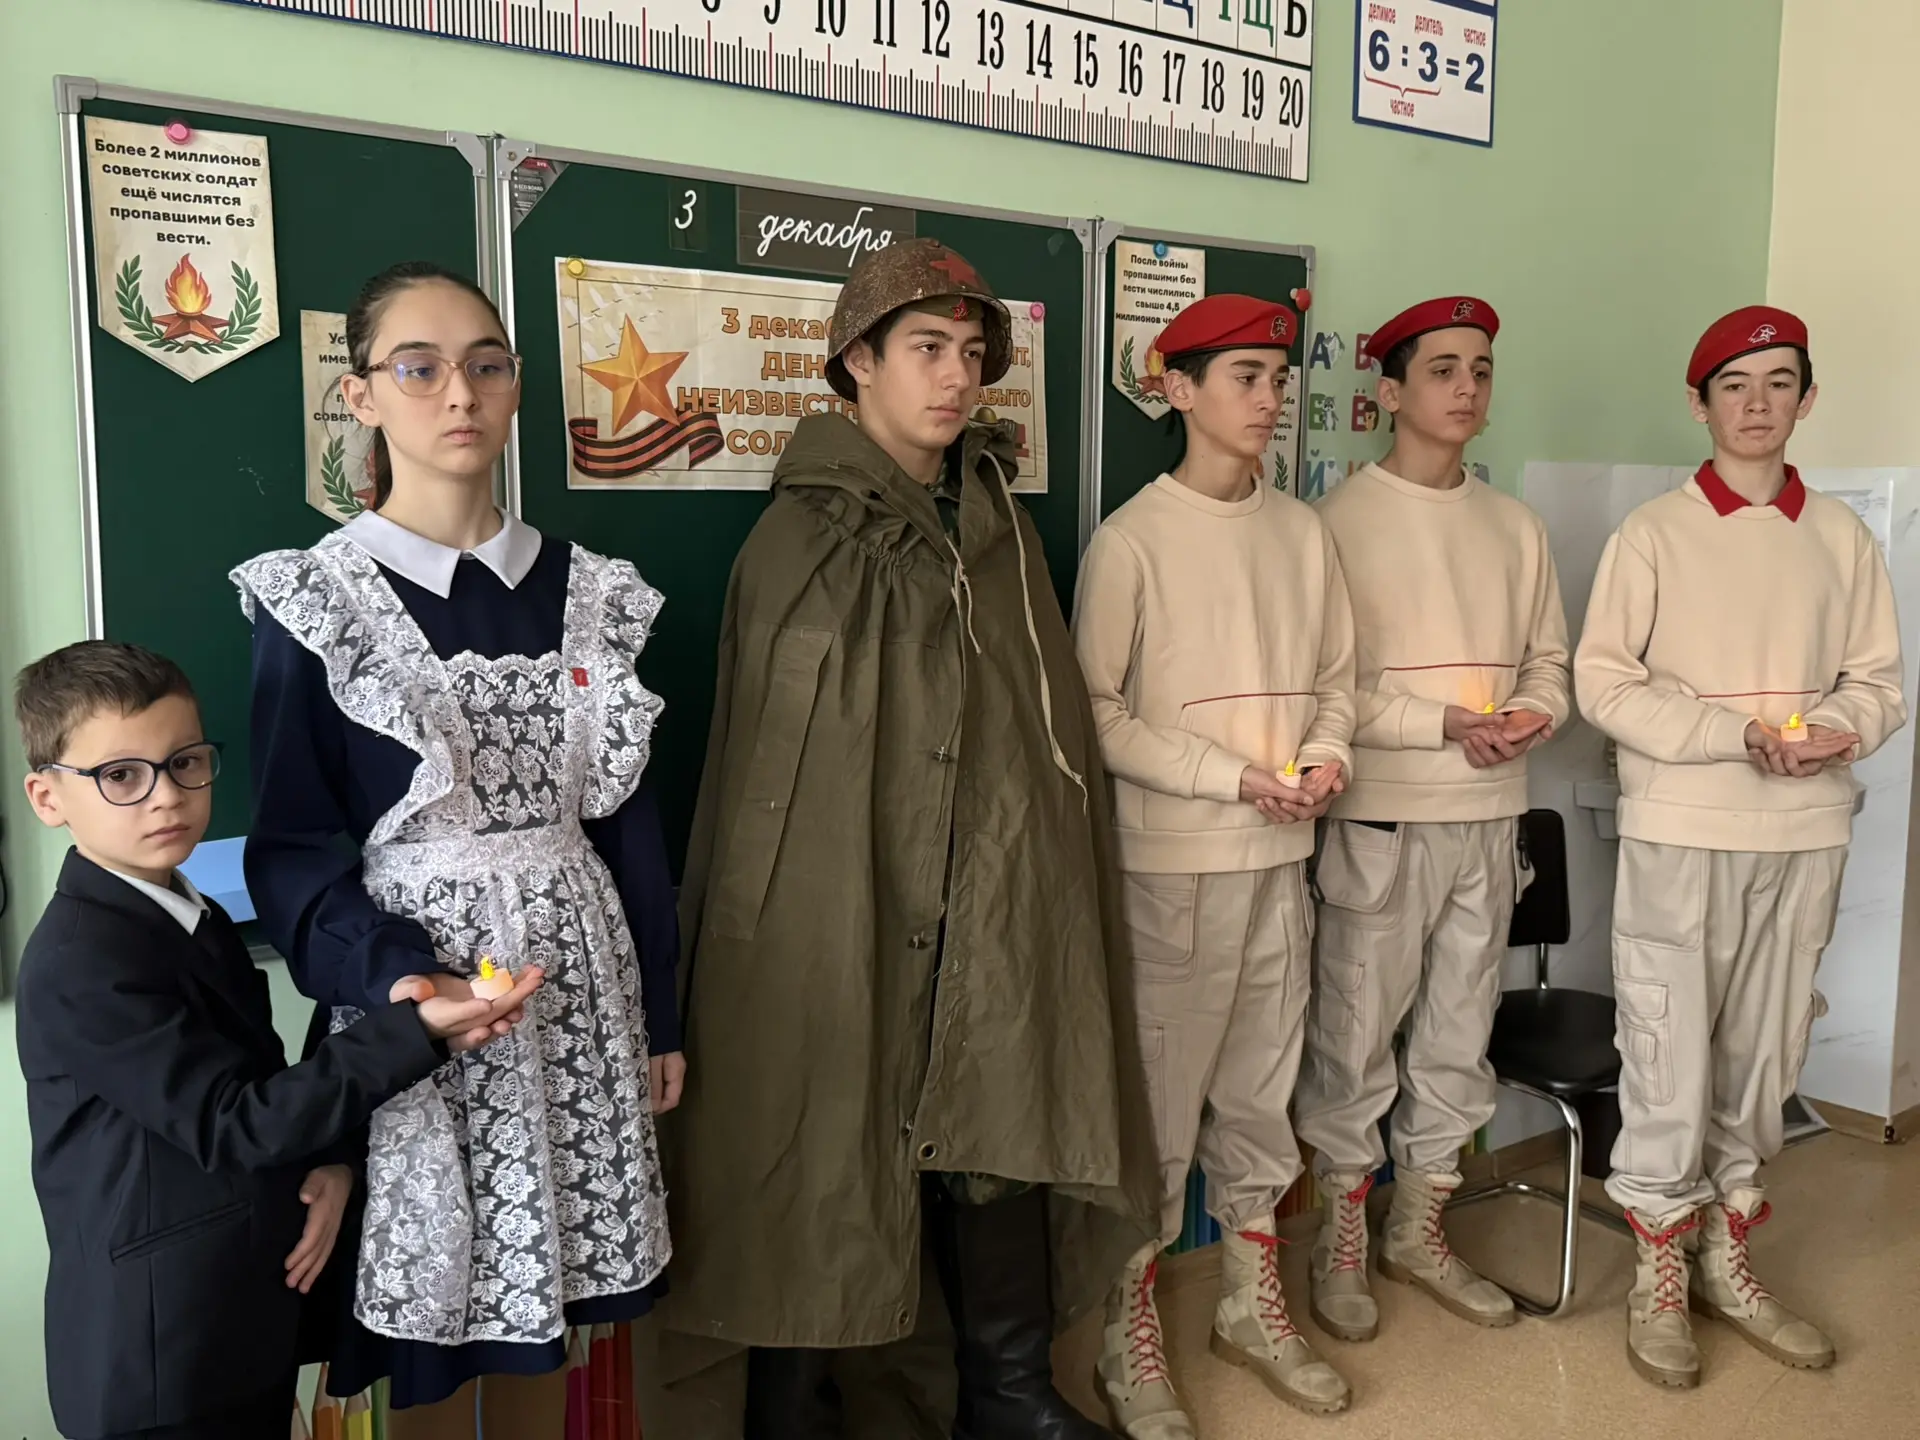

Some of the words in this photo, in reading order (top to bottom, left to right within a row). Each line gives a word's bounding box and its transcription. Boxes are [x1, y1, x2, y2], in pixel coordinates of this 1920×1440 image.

[1368, 3, 1396, 25] делимое
[1414, 15, 1443, 36] делитель
[1463, 27, 1486, 47] частное
[873, 0, 897, 48] 11
[922, 0, 950, 58] 12
[977, 8, 1004, 69] 13
[1026, 19, 1052, 79] 14
[1073, 30, 1099, 88] 15
[1118, 40, 1143, 97] 16
[1162, 50, 1186, 104] 17
[1201, 58, 1225, 113] 18
[1242, 67, 1264, 121] 19
[1279, 76, 1303, 128] 20
[1390, 99, 1415, 118] частное
[95, 138, 147, 157] Более
[150, 145, 160, 159] 2
[164, 150, 261, 167] миллионов
[102, 162, 192, 183] советских
[195, 171, 257, 187] солдат
[121, 186, 157, 202] ещё
[161, 191, 241, 206] числятся
[110, 206, 222, 226] пропавшими
[225, 213, 255, 228] без
[156, 231, 211, 245] вести.
[675, 189, 697, 229] 3
[757, 206, 896, 268] декабря
[1131, 254, 1157, 266] После
[1159, 258, 1188, 269] войны
[1123, 269, 1178, 282] пропавшими
[1180, 274, 1196, 284] без
[1123, 284, 1146, 293] вести
[1148, 287, 1195, 298] числились
[1135, 300, 1164, 310] свыше
[1166, 302, 1180, 312] 4,5
[721, 307, 740, 334] 3
[1115, 312, 1161, 324] миллионов
[761, 351, 826, 381] ДЕН
[677, 387, 859, 419] НЕИЗВЕСТН
[973, 388, 1031, 407] АБЫТО
